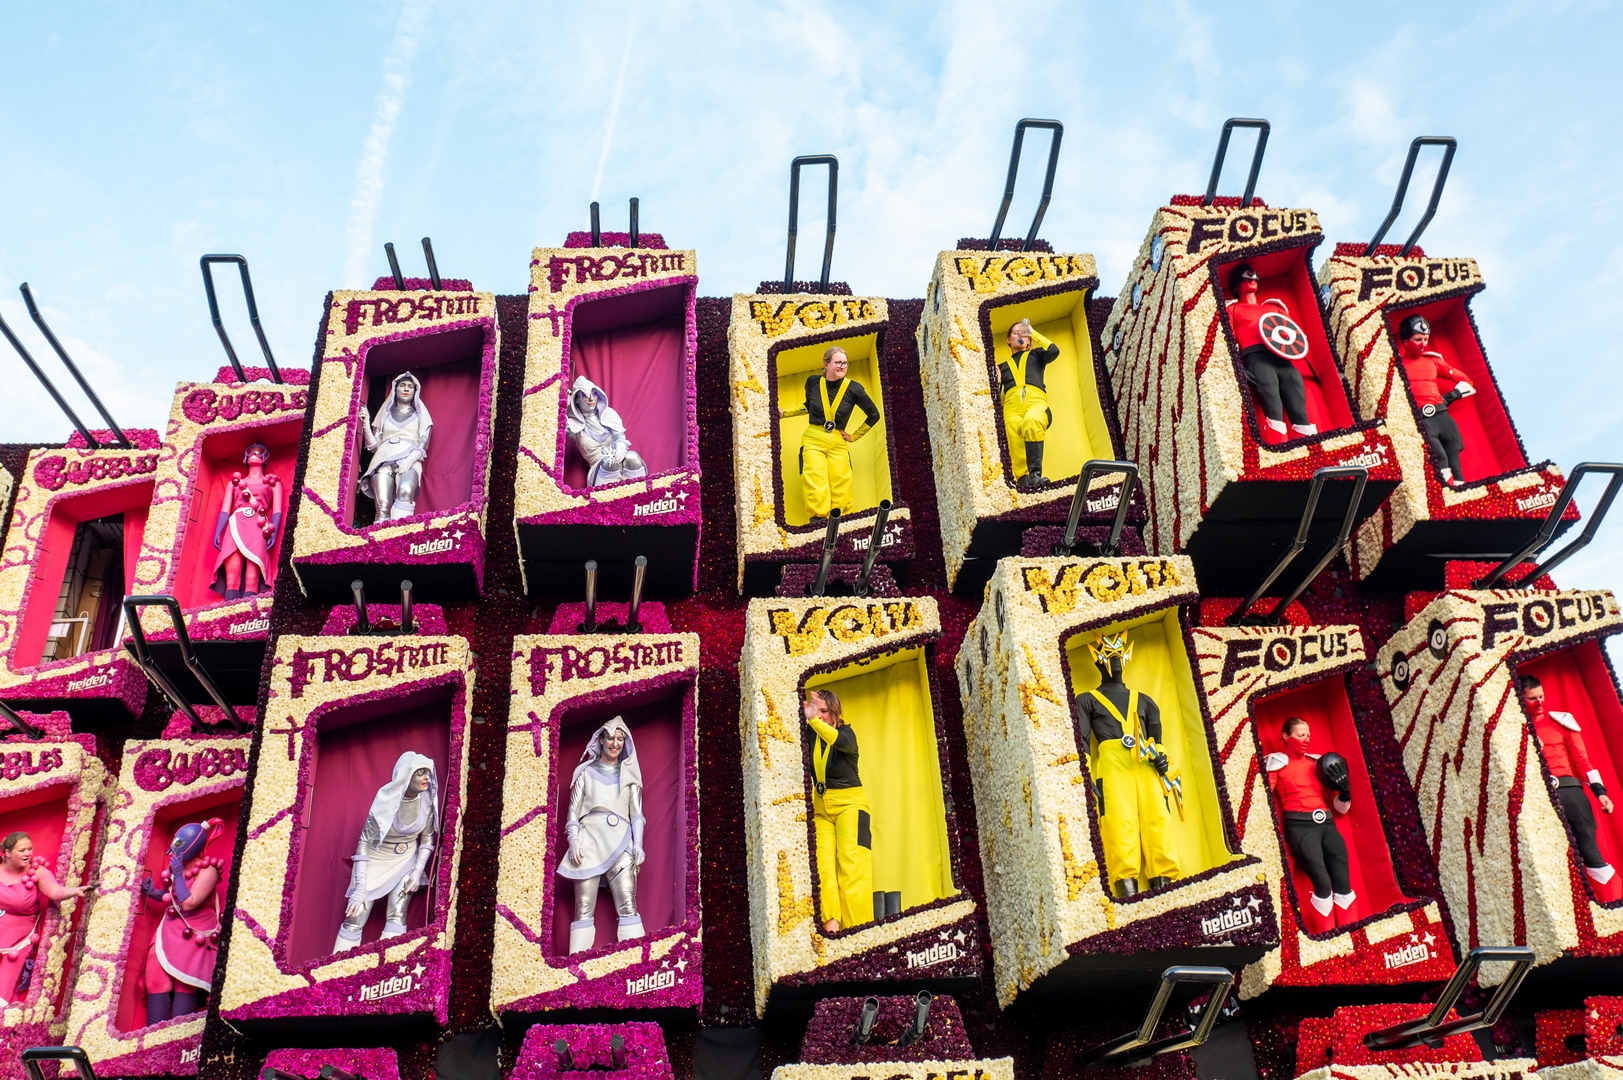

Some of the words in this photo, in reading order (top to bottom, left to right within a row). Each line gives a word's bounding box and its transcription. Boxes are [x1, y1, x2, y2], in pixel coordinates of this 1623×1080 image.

[1187, 212, 1307, 254] FOCUS
[547, 252, 685, 293] FROSTBITE
[953, 256, 1085, 294] VOLTA
[1358, 263, 1470, 302] FOCUS
[342, 295, 481, 335] FROSTBITE
[749, 300, 875, 338] VOLTA
[633, 498, 677, 516] helden
[1086, 494, 1119, 513] helde
[1515, 493, 1556, 513] helden
[408, 538, 453, 555] helden
[853, 533, 894, 551] helen
[1021, 560, 1181, 617] VOLTA
[229, 618, 270, 635] helden
[767, 602, 923, 658] VOLTA
[1481, 595, 1605, 650] FOCUS
[286, 642, 449, 699] FROSTBITE
[526, 641, 683, 697] FROSTBITE
[1220, 633, 1348, 687] FOCUS
[66, 674, 108, 692] helden
[0, 748, 63, 781] BLES
[1202, 908, 1253, 936] helden
[906, 942, 957, 969] helden
[1383, 944, 1429, 969] helden
[359, 976, 412, 1002] helden
[625, 970, 675, 995] helden
